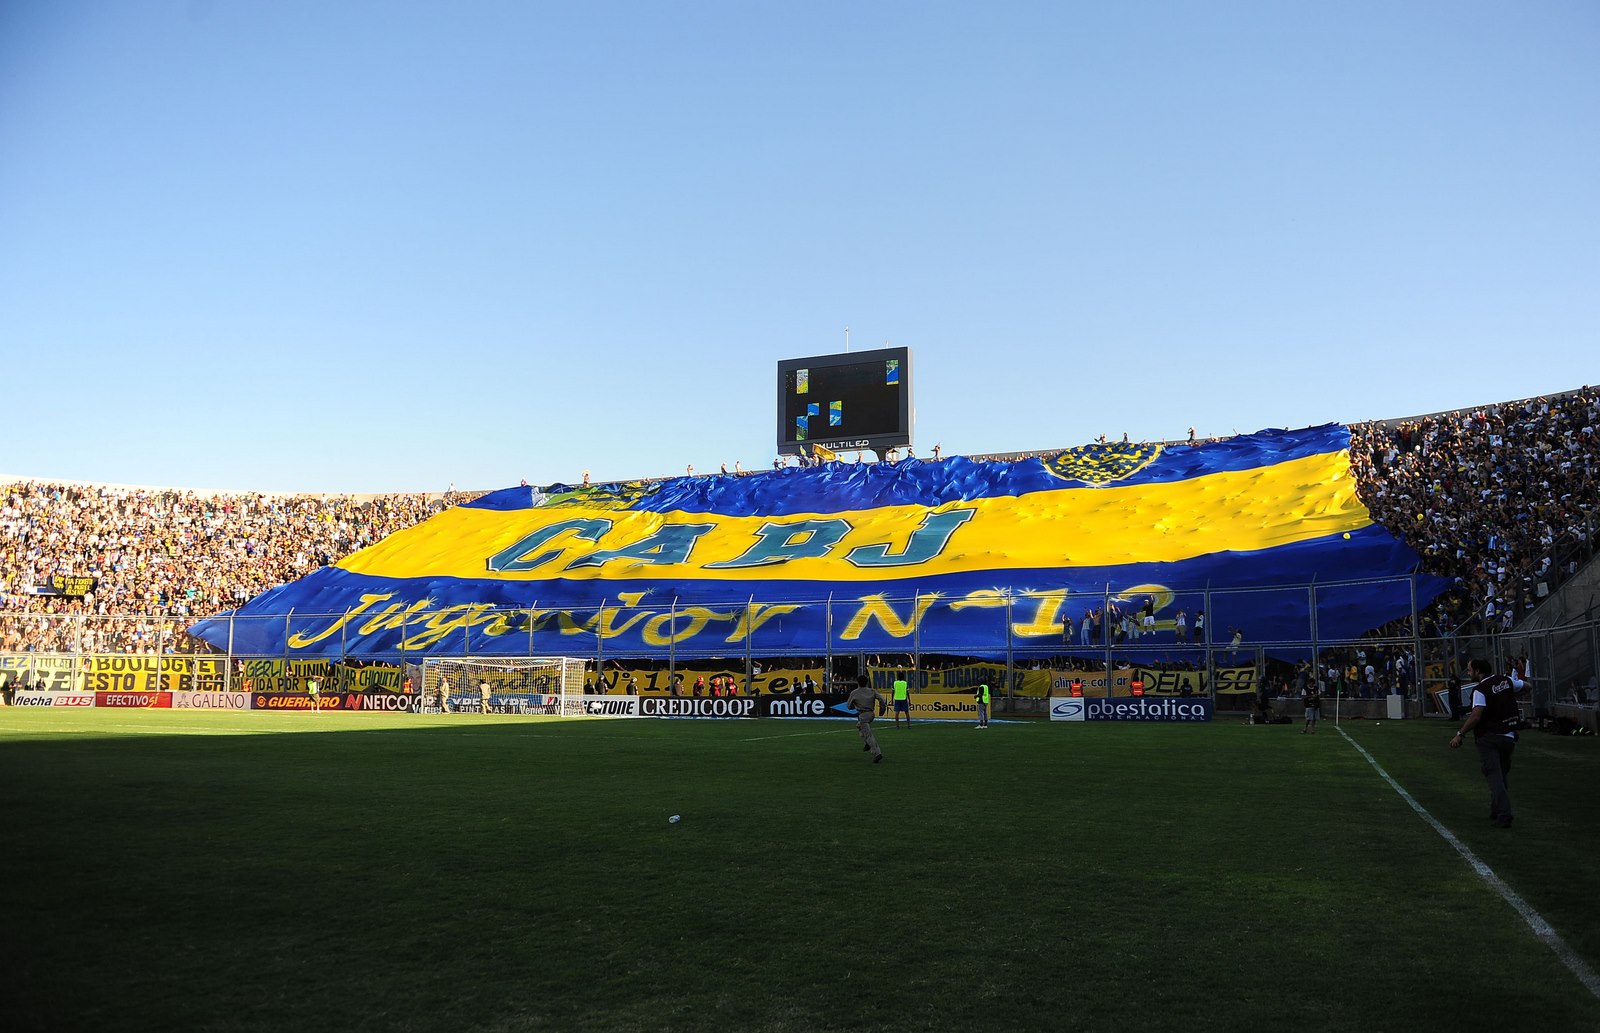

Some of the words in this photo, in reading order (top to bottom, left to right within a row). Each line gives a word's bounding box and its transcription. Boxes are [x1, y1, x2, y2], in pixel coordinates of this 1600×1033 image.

[83, 673, 136, 691] ESTO
[145, 673, 170, 691] ES
[15, 696, 53, 706] flecha
[54, 696, 92, 706] BUS
[192, 694, 245, 709] GALENO
[642, 698, 755, 716] CREDICOOP
[770, 696, 825, 715] mitre
